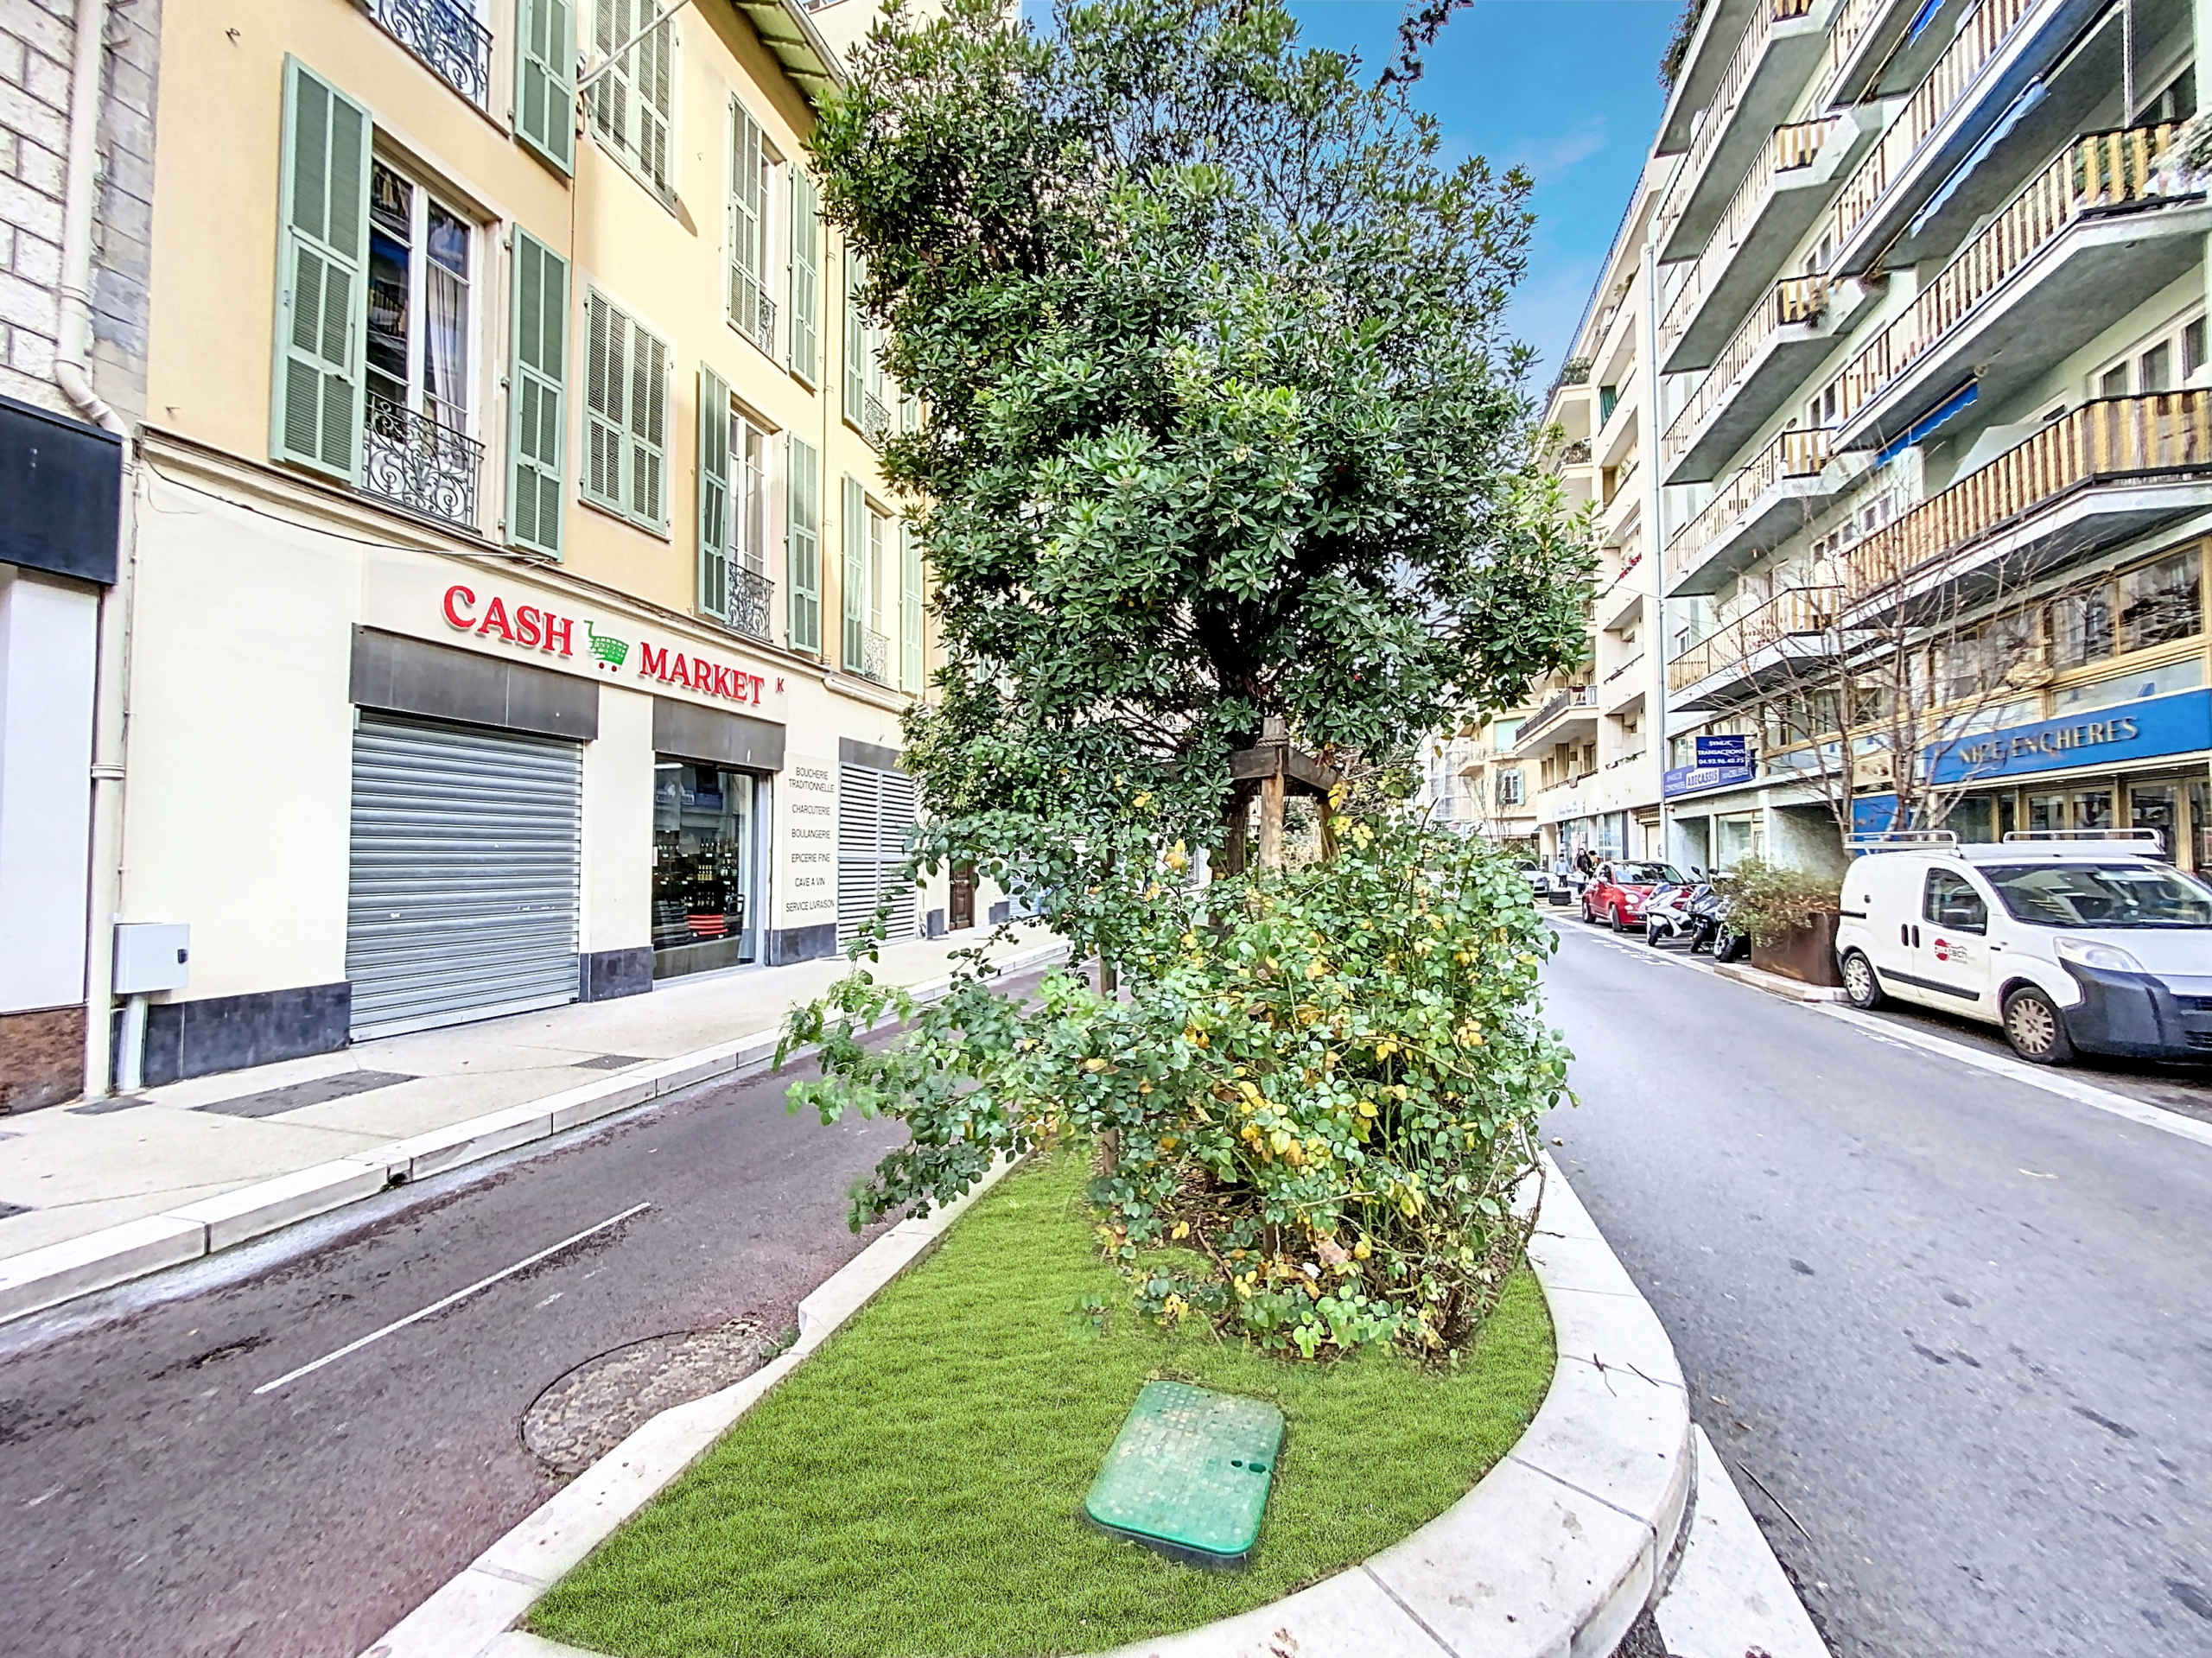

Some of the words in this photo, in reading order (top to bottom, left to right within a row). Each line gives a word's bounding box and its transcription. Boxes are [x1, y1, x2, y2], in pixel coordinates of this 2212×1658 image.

[443, 585, 574, 657] CASH
[639, 642, 765, 705] MARKET
[2012, 716, 2139, 758] ENCHERES
[796, 766, 829, 780] BOUCHERIE
[788, 778, 835, 793] TRADITIONNELLE
[791, 804, 830, 816] CHARCUTERIE
[791, 829, 830, 839] BOULANGERIE
[791, 853, 817, 863] EPICERIE
[817, 853, 830, 862] FINE
[795, 877, 810, 887] CAVE
[811, 877, 816, 886] A
[816, 876, 825, 886] VIN
[785, 901, 809, 912] SERVICE
[810, 899, 835, 911] LIVRAISON
